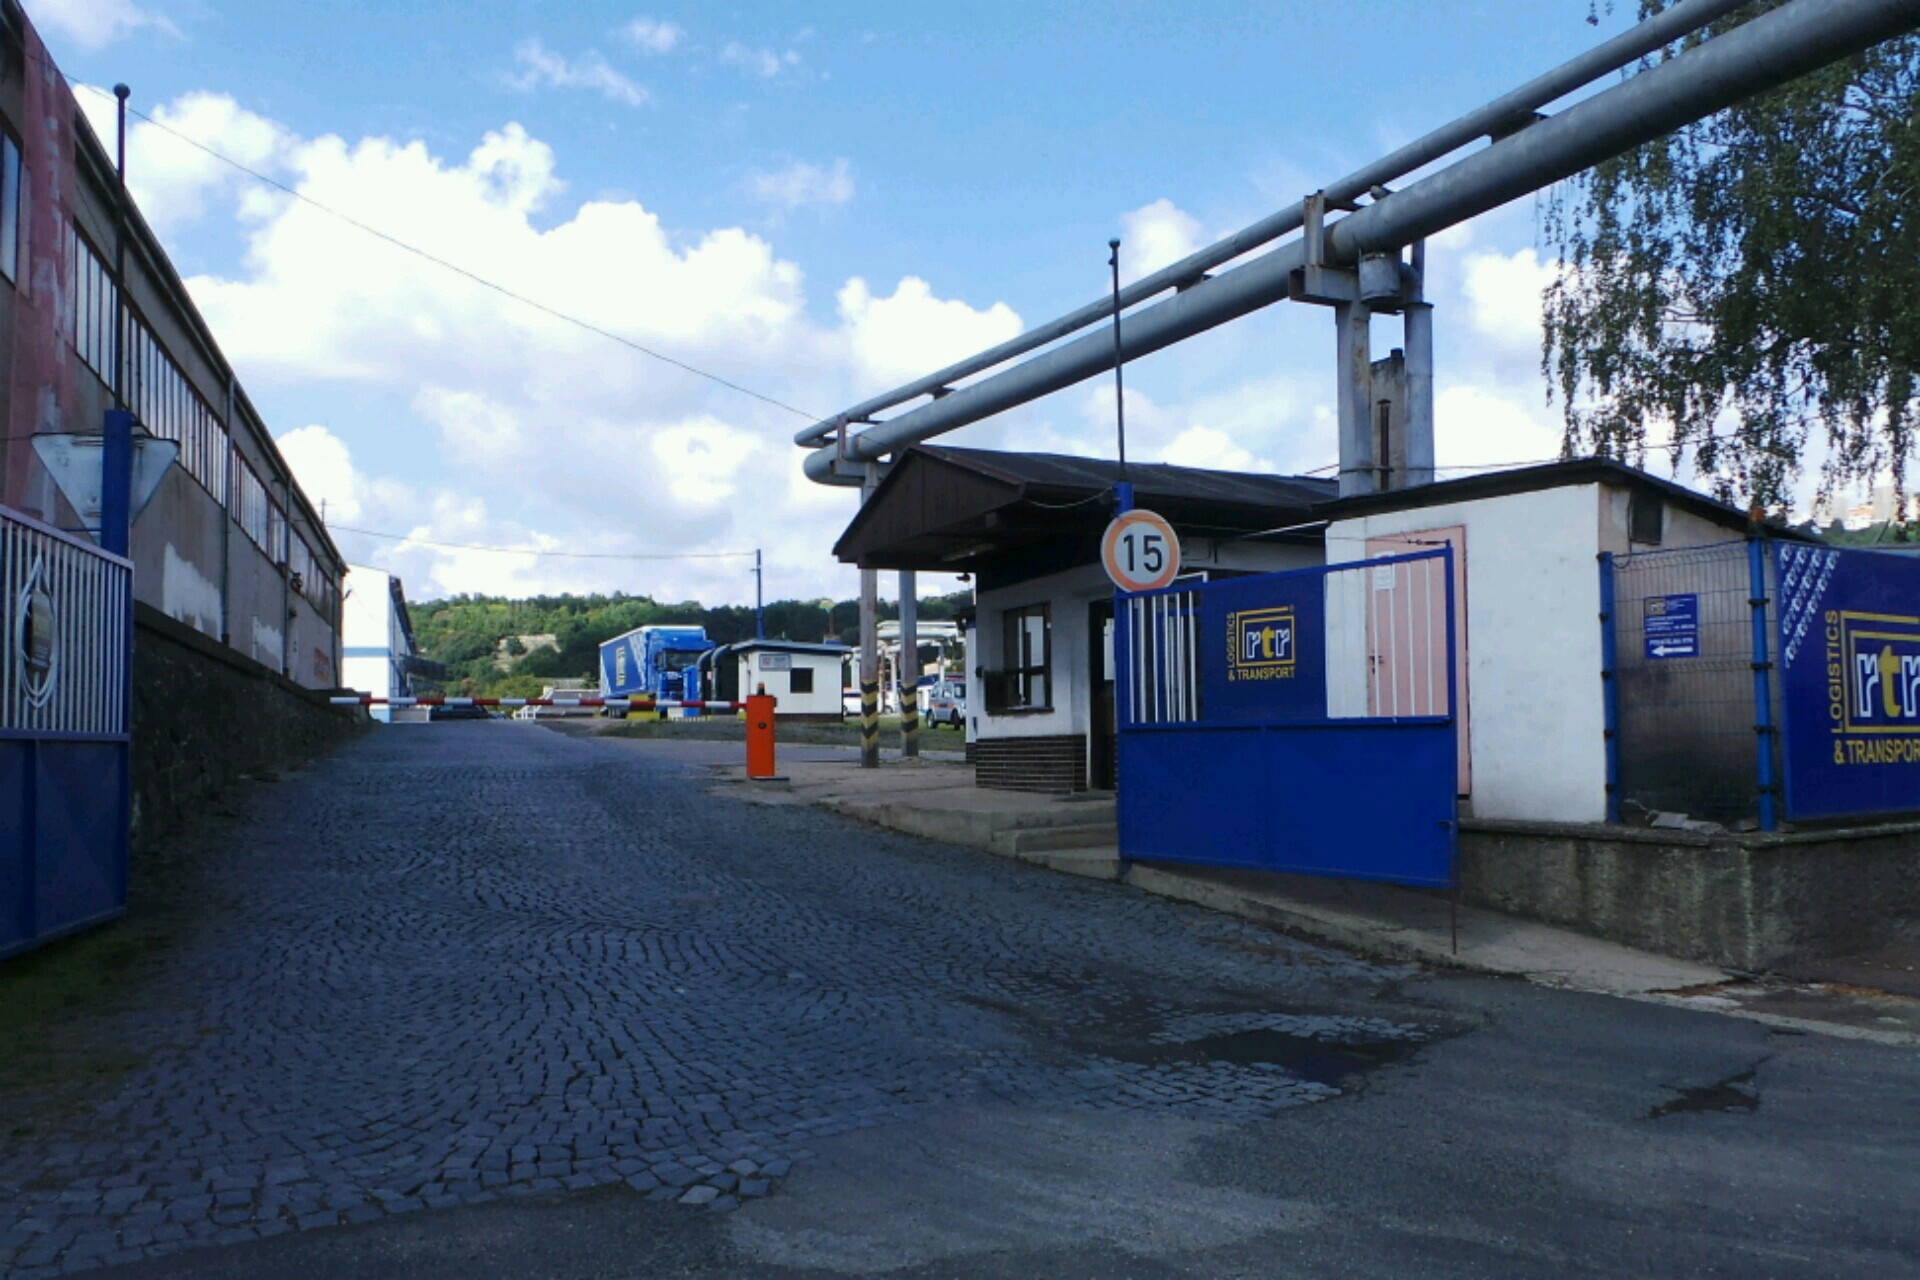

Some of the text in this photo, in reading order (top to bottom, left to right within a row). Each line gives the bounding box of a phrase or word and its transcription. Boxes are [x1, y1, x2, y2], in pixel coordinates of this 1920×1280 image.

[1123, 533, 1162, 573] 15
[1226, 612, 1235, 668] LOGISTICS
[1246, 626, 1290, 659] rtr
[1228, 666, 1295, 681] & TRANSPORT
[1825, 610, 1842, 733] LOGISTICS
[1856, 645, 1920, 717] rtr
[1834, 740, 1844, 764] &
